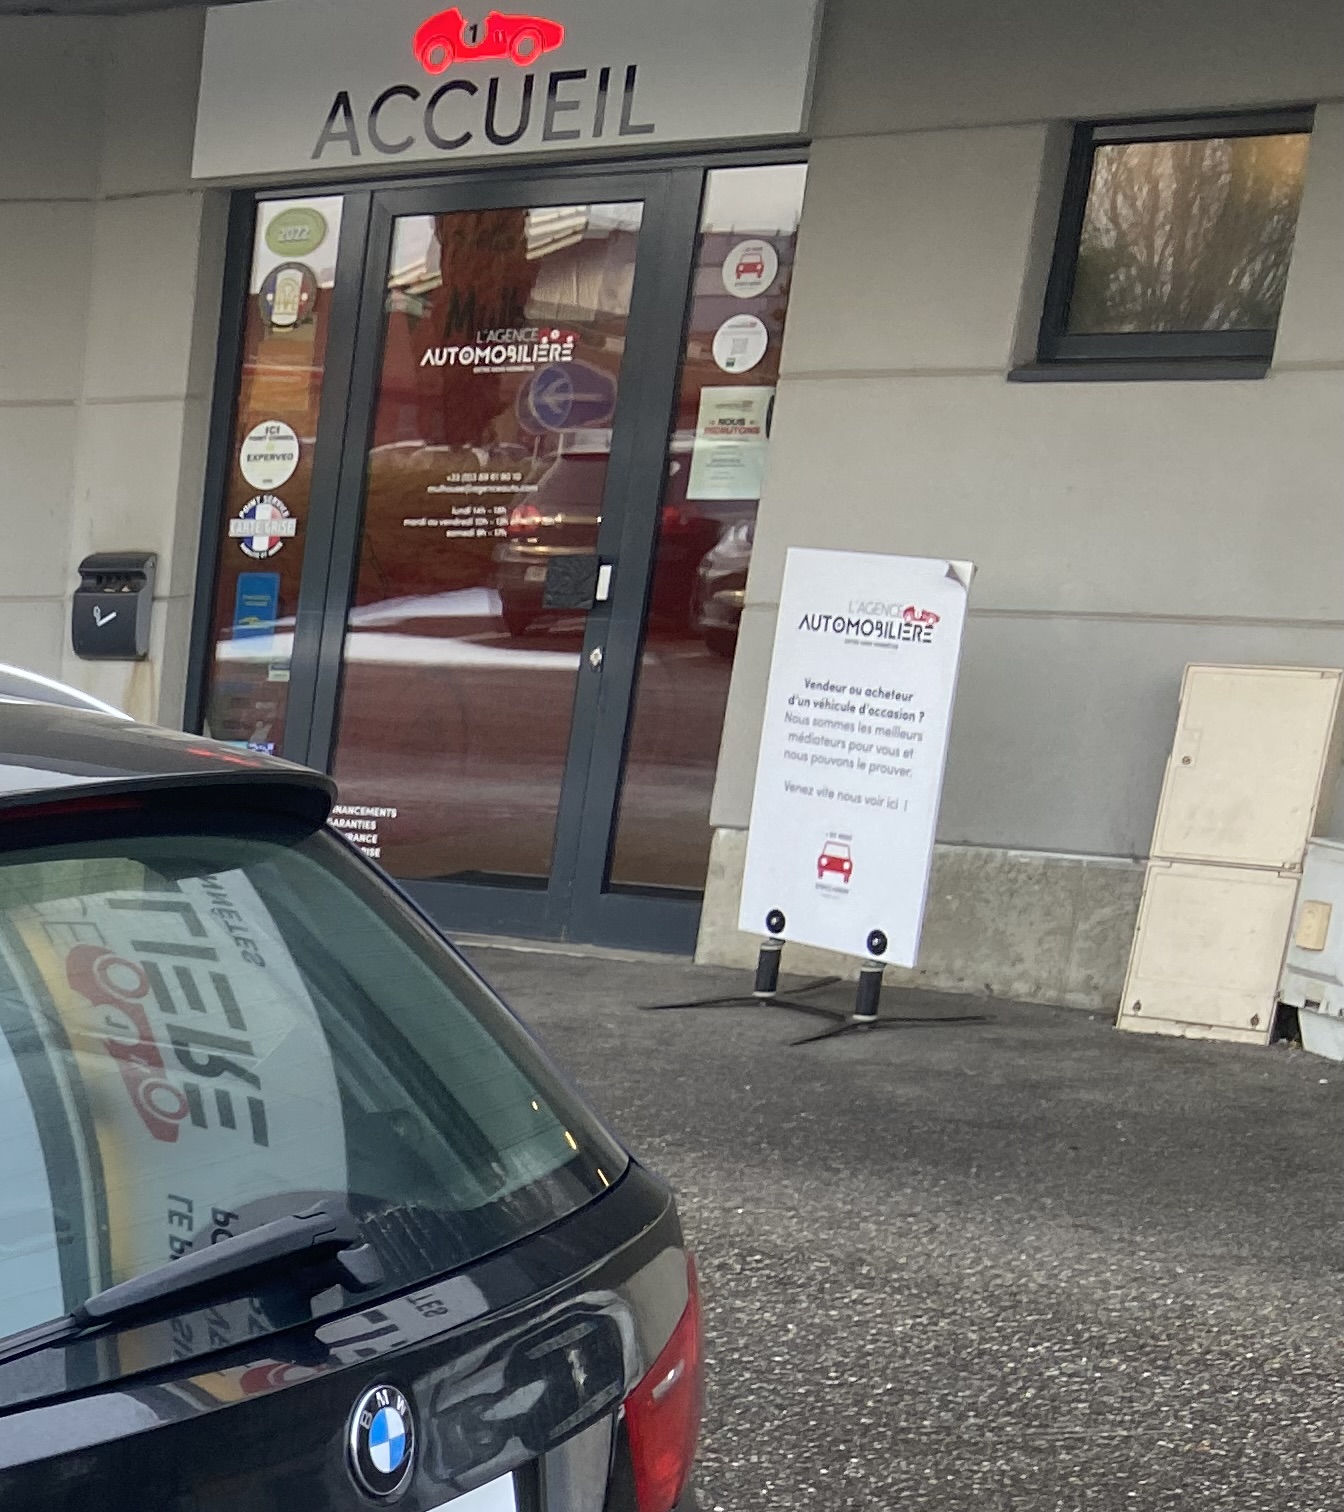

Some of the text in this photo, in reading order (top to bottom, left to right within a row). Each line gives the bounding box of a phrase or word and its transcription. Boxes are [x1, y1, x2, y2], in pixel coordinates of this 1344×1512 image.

[311, 64, 656, 160] ACCUEIL
[476, 328, 539, 344] L'AGENCE
[848, 600, 903, 615] L'AGENCE
[804, 677, 914, 702] Vendeur ou acheteur
[788, 696, 925, 723] d'un véhicule d'occasion ?
[784, 712, 923, 742] Nous sommes les meilleurs
[788, 731, 914, 759] médiateurs pour vous et
[784, 751, 808, 762] nous
[811, 754, 854, 769] pouvons
[856, 757, 866, 769] le
[784, 780, 813, 796] Venez
[816, 785, 835, 799] vite
[837, 791, 862, 804] nous
[864, 797, 884, 808] voir
[886, 798, 899, 810] ici
[359, 1388, 407, 1430] BMW
